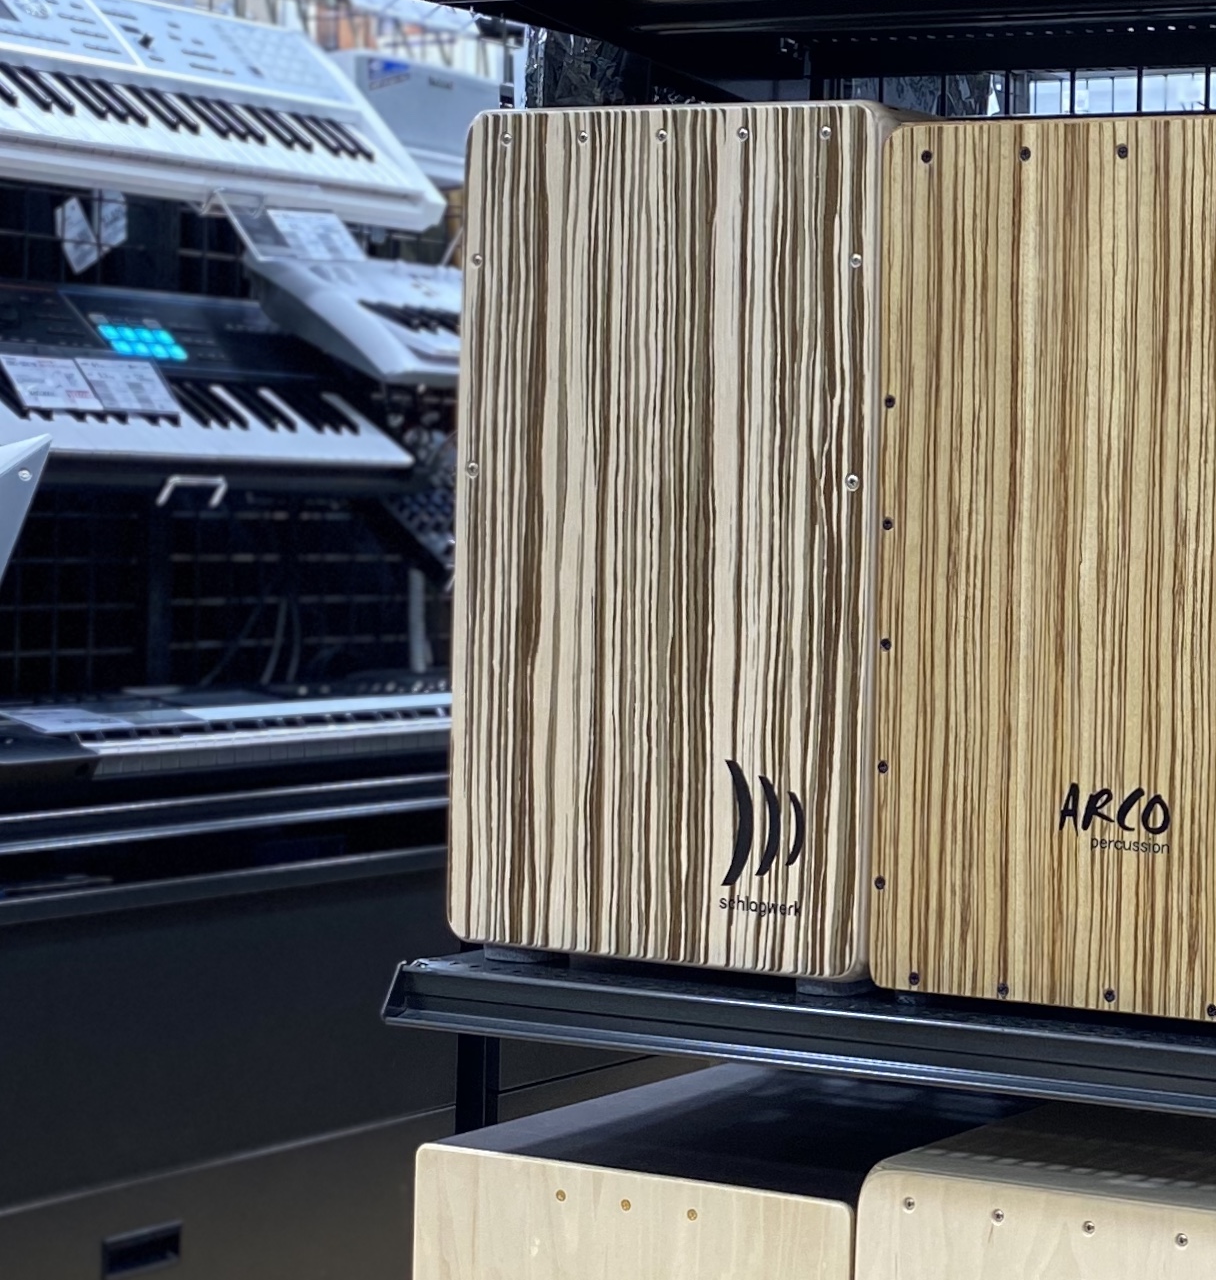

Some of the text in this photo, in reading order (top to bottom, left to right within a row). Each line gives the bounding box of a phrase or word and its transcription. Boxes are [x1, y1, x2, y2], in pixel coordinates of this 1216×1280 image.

[1058, 782, 1171, 836] ARCO
[1090, 837, 1170, 854] percussion
[718, 894, 803, 917] schlagwerk
